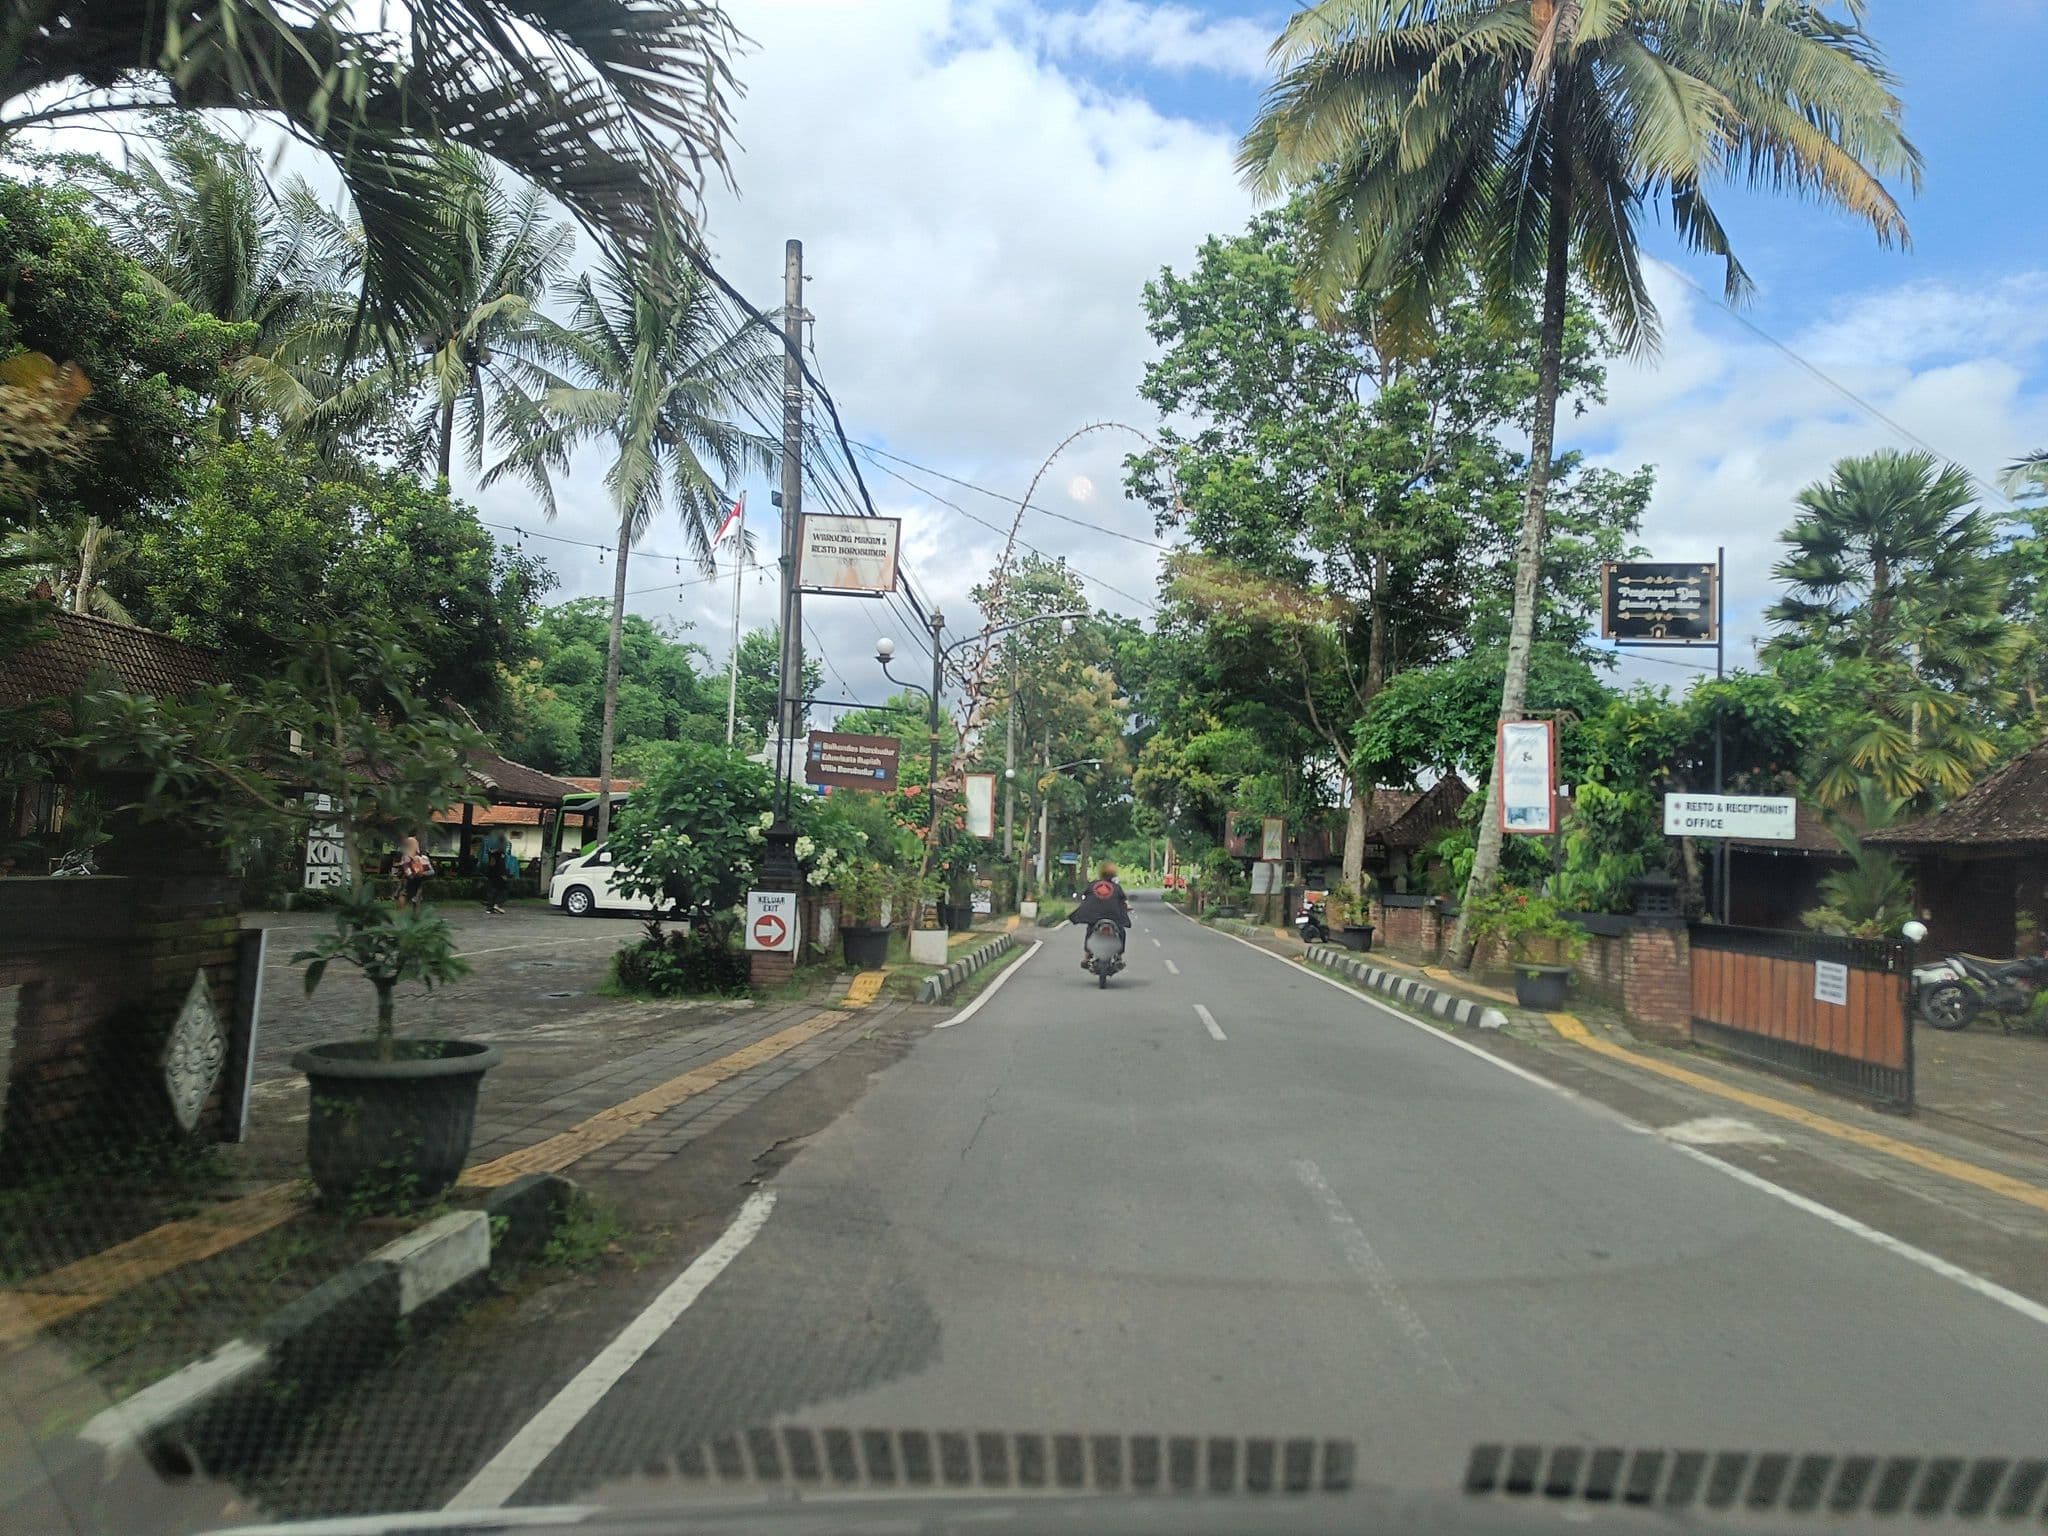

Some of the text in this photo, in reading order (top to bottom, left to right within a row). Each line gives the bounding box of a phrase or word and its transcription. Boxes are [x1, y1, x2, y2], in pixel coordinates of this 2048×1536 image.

[811, 544, 886, 557] RESTO BOROBUDUR
[1686, 802, 1789, 815] RESTO & RECEPTIONIST
[1686, 818, 1723, 829] OFFICE
[758, 896, 785, 904] KELUAR
[763, 904, 778, 912] EXIT
